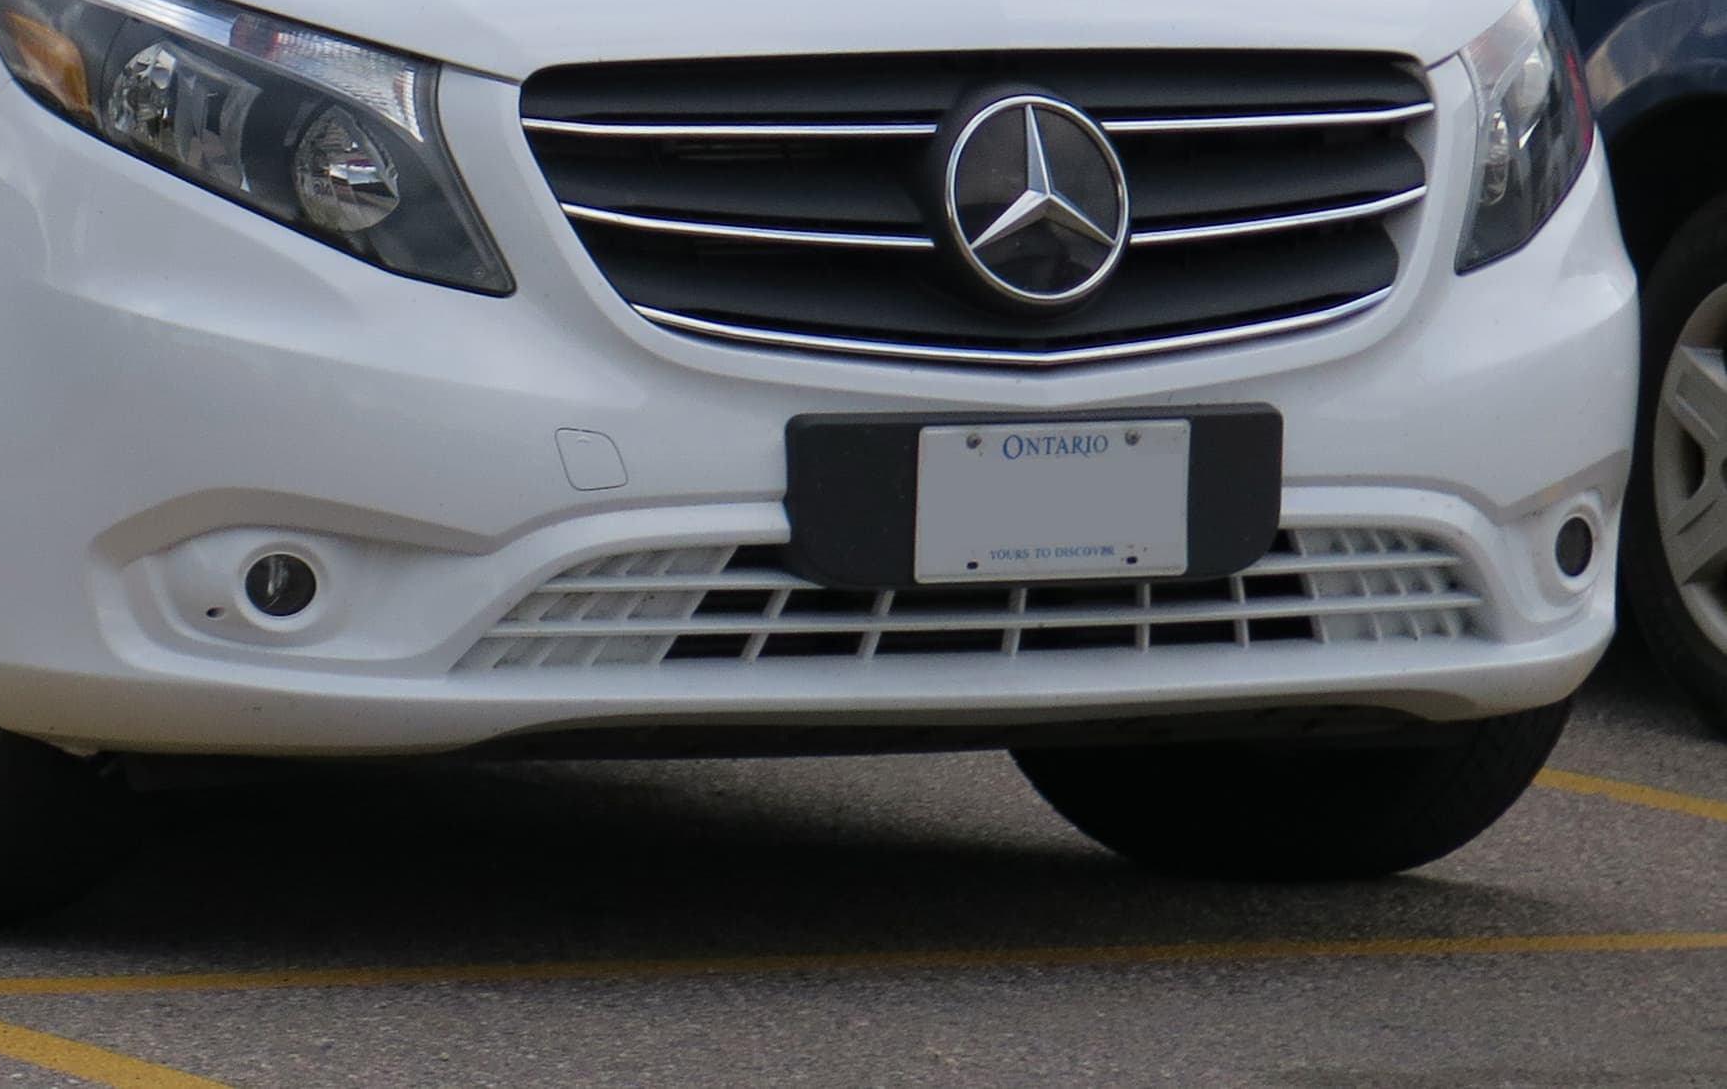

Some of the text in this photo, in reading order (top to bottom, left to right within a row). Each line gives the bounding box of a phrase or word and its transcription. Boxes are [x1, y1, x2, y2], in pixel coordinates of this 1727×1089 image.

[1003, 434, 1109, 459] ONTARIO
[990, 549, 1030, 561] YOURS
[1035, 547, 1052, 559] TO
